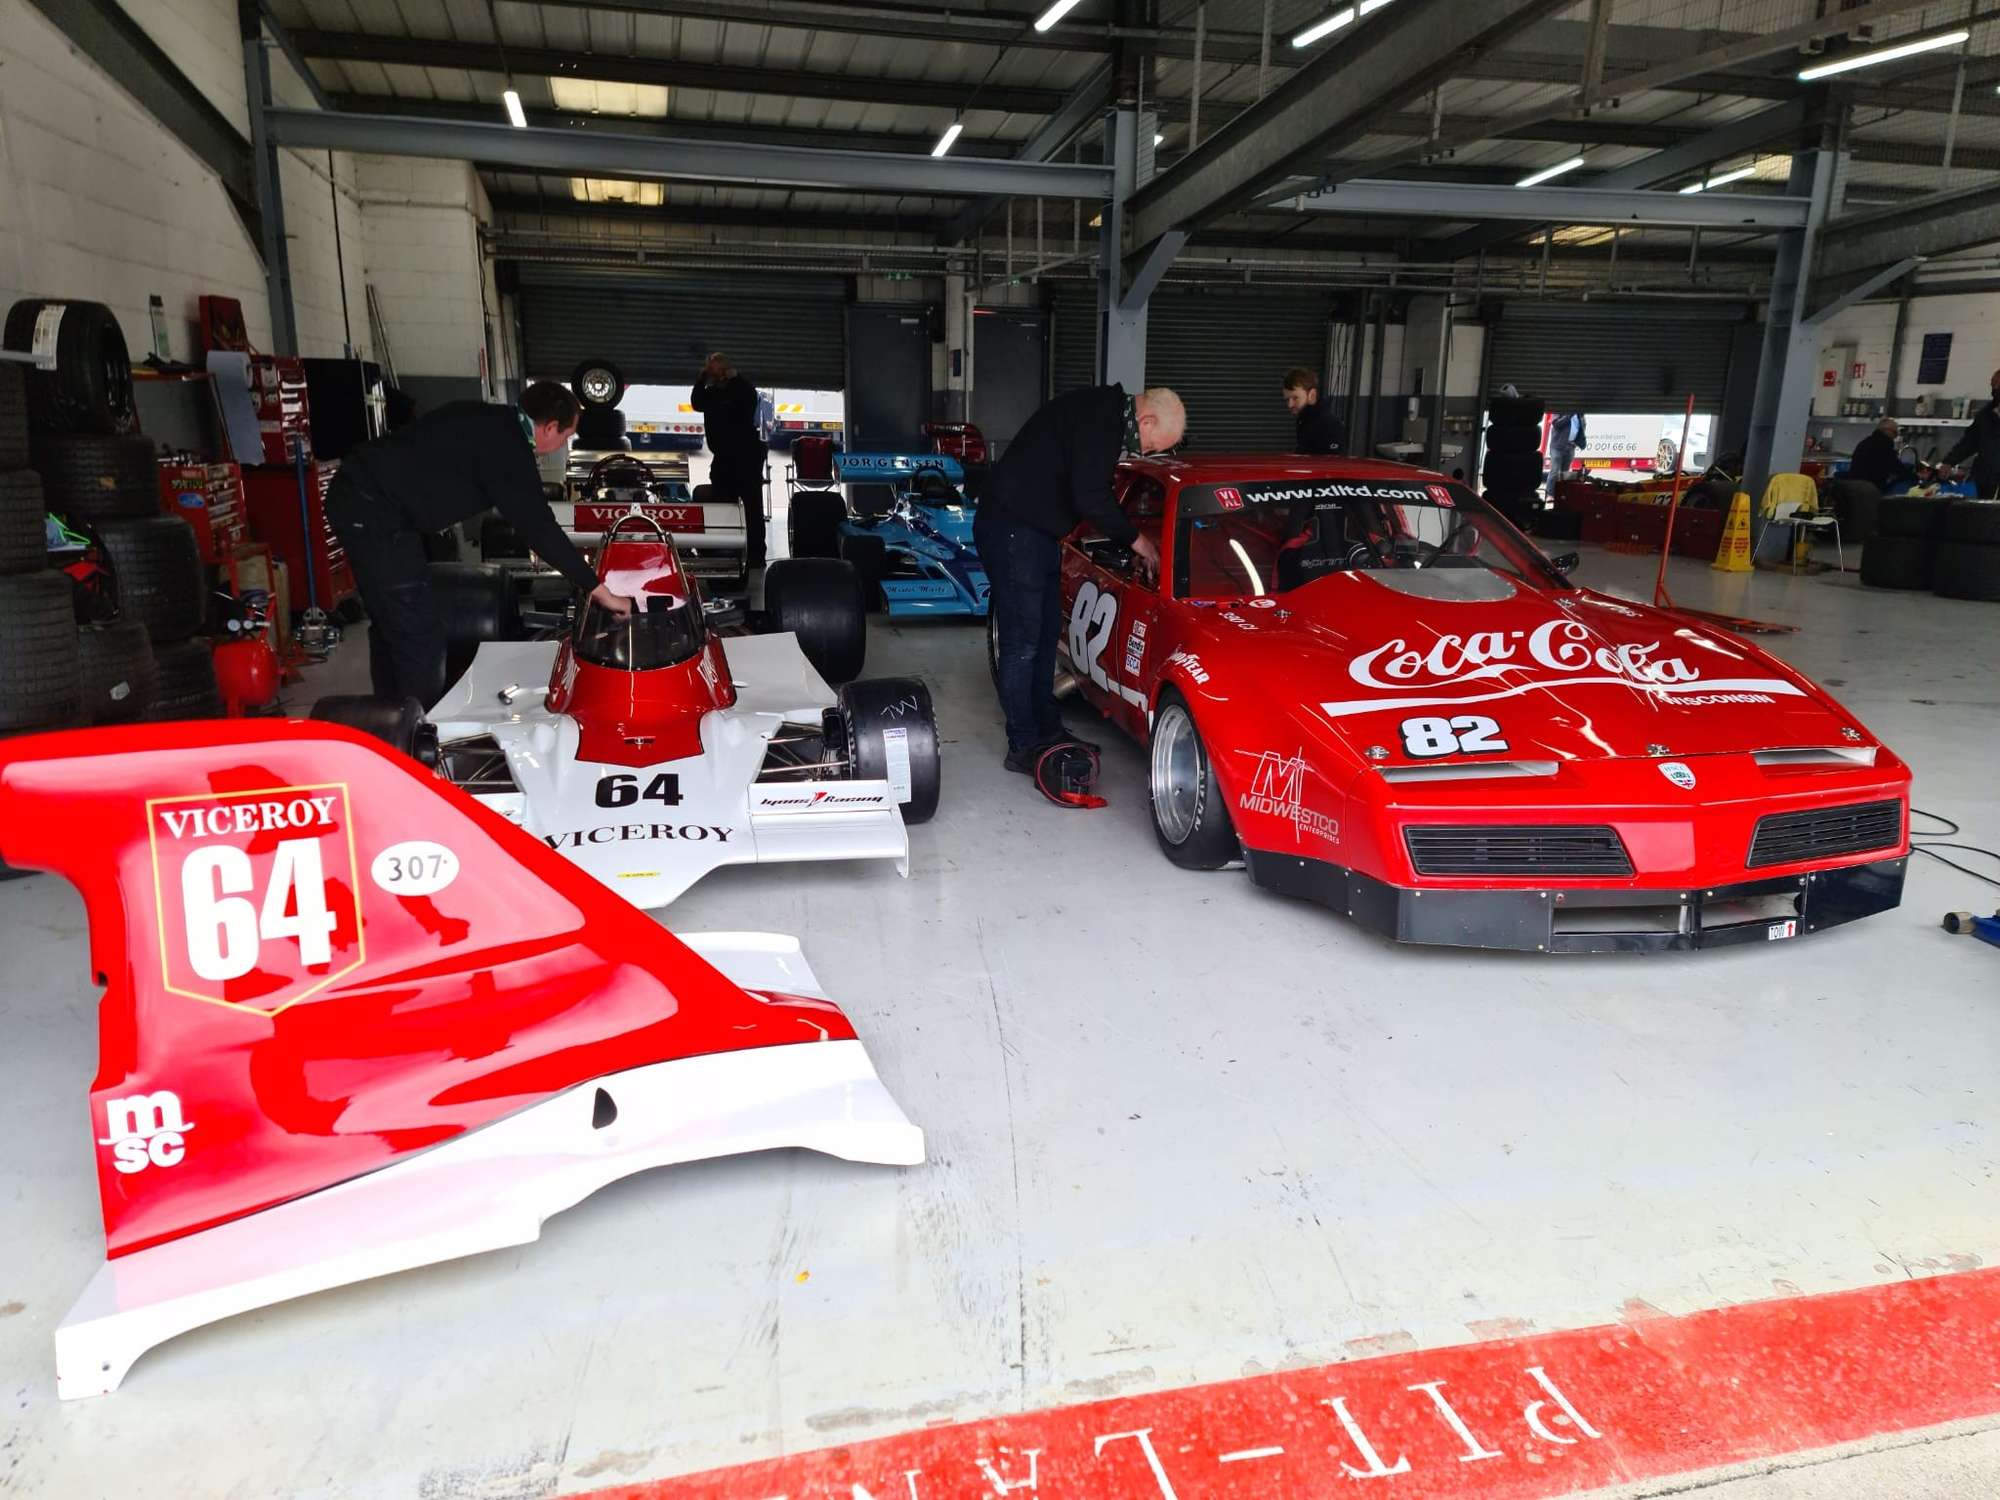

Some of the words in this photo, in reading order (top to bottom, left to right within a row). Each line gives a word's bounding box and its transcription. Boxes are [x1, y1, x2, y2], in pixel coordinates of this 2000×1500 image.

[842, 457, 944, 469] JORGENSEN
[1247, 485, 1429, 503] www.xlltd.com
[591, 508, 688, 521] VICROY
[1068, 581, 1118, 692] 82
[1348, 619, 1700, 690] Coca-Cola
[1401, 715, 1509, 757] 82
[594, 773, 684, 808] 64
[161, 796, 337, 840] VICEROY
[1239, 792, 1339, 836] MIDWESTCO
[543, 823, 734, 850] VICEROY
[387, 854, 443, 881] 307
[181, 837, 338, 981] 64
[1770, 925, 1785, 938] TOW
